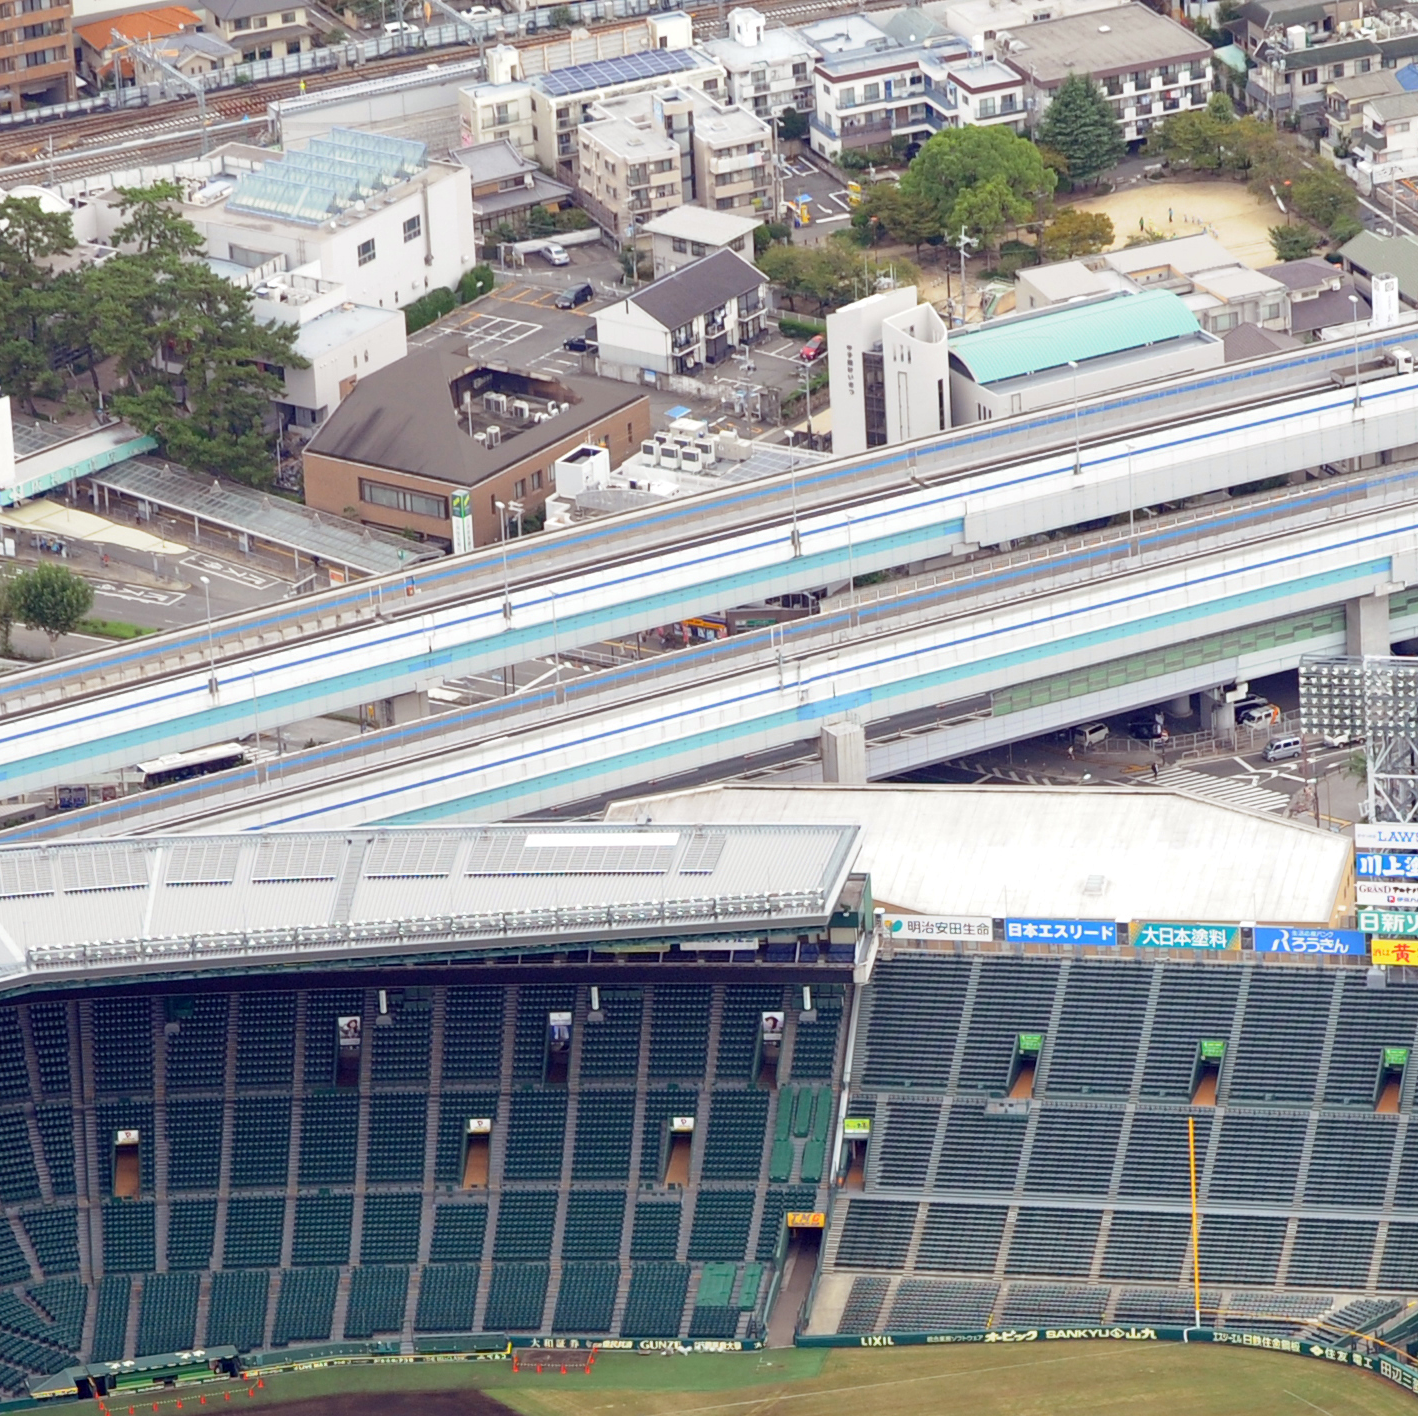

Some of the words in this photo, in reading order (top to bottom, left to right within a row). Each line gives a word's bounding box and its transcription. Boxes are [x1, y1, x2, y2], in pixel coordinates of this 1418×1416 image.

[908, 920, 990, 936] 明治安田生命
[1008, 922, 1114, 941] 日本エスリード
[1142, 926, 1227, 948] 大日本塗料
[1292, 937, 1349, 953] ろうきん
[984, 1330, 1038, 1343] オービック
[1046, 1328, 1108, 1340] SANKYU
[1126, 1327, 1157, 1340] 山九
[531, 1338, 580, 1349] 大和証券
[861, 1336, 894, 1346] LIXIL
